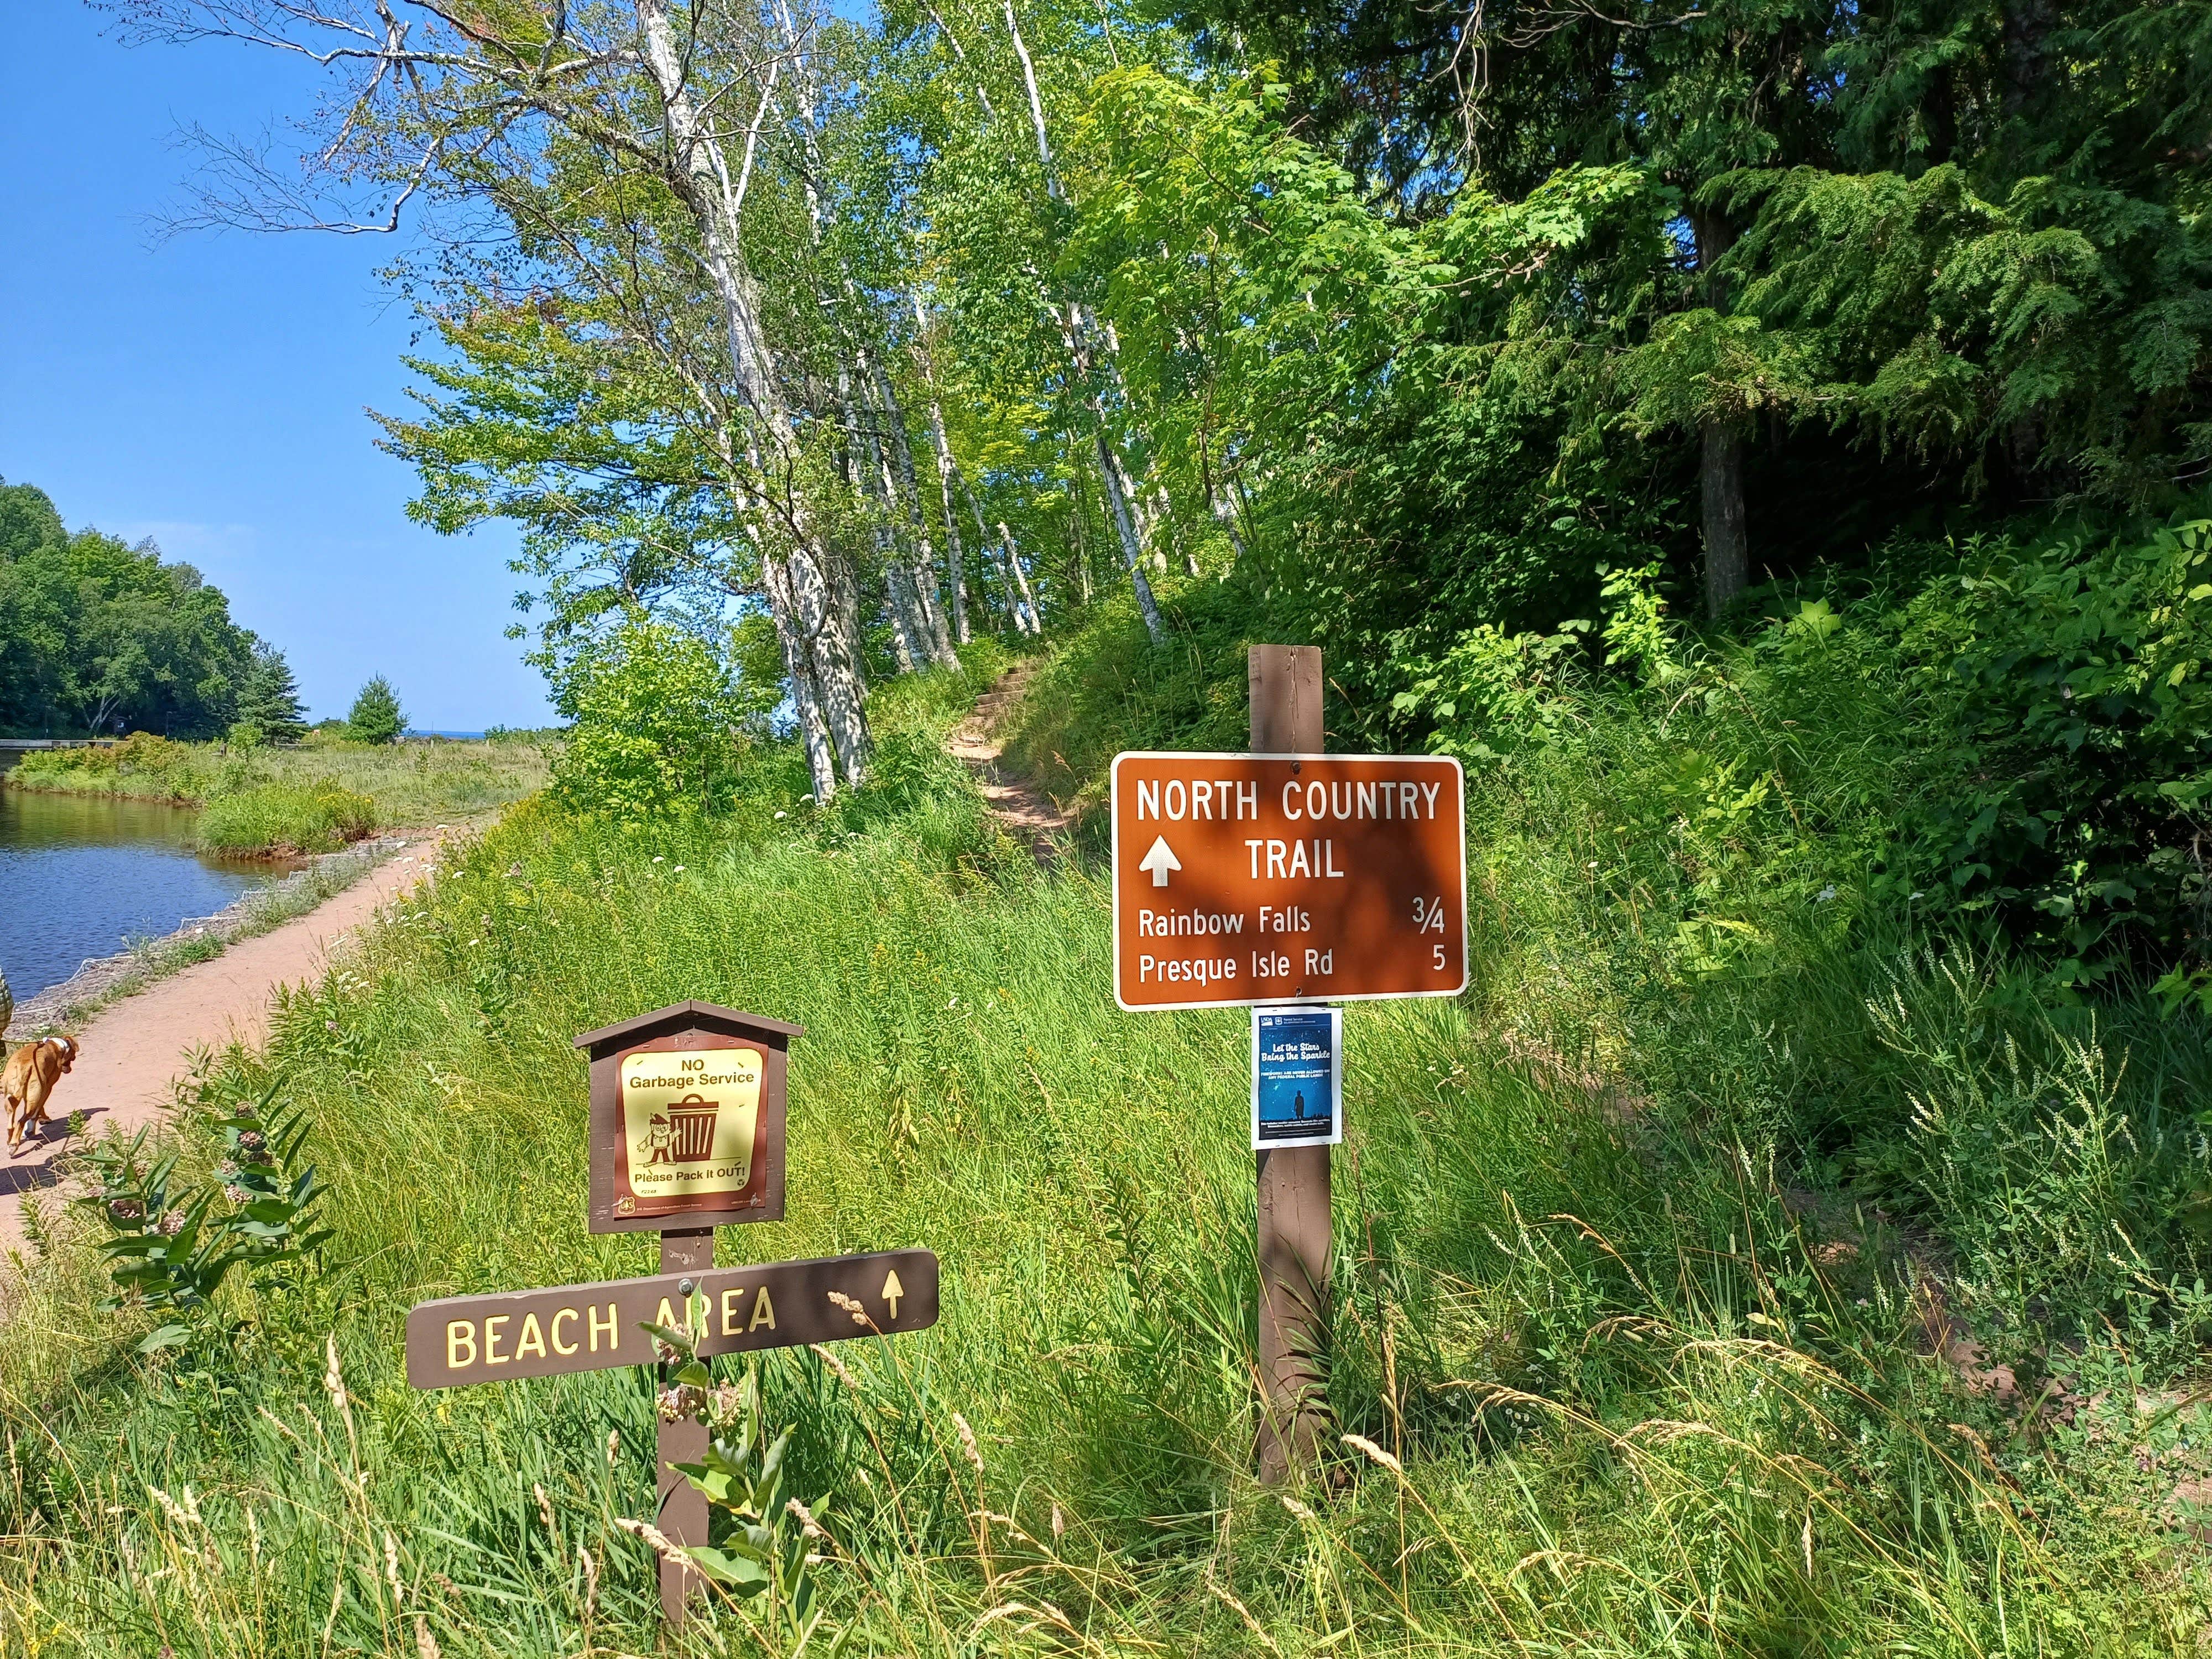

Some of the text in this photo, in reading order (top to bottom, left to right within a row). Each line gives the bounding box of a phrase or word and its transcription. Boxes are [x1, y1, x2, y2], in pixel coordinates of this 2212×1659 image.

[1136, 779, 1441, 821] NORTH COUNTRY
[1245, 838, 1344, 879] TRAIL
[1139, 909, 1244, 937] Rainbow
[1259, 905, 1311, 933] Falls
[1139, 944, 1446, 987] Presque Isle Rd 5
[1261, 1050, 1331, 1062] Bring the Sparkle
[1273, 1042, 1320, 1052] Let the Stars
[681, 1059, 705, 1071] NO
[630, 1072, 754, 1089] Garbage Service
[635, 1167, 745, 1183] Please Pack it OUT!
[447, 1286, 776, 1369] BEACH AREA
